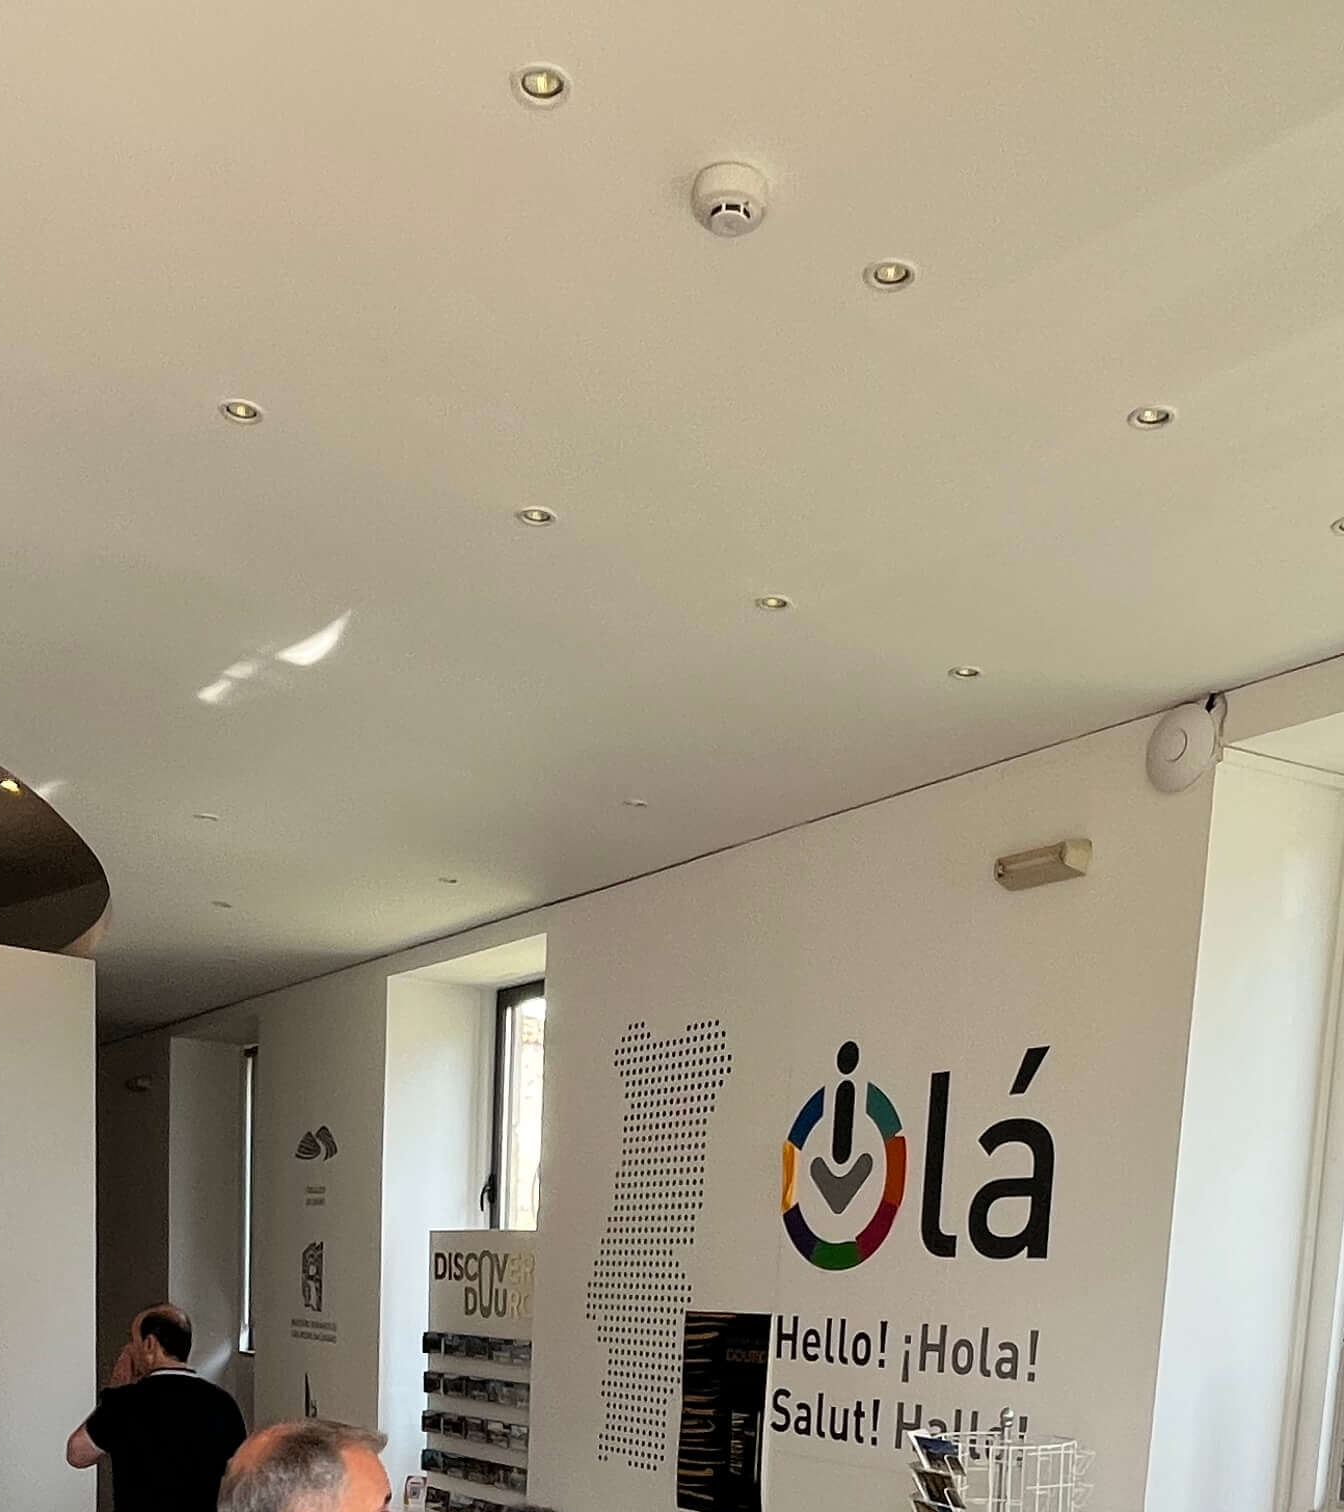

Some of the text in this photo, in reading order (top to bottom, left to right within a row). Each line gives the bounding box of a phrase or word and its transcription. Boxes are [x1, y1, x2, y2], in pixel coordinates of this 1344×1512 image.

[775, 1315, 1040, 1383] Hello! ¡Hola!
[770, 1388, 880, 1447] Salut!
